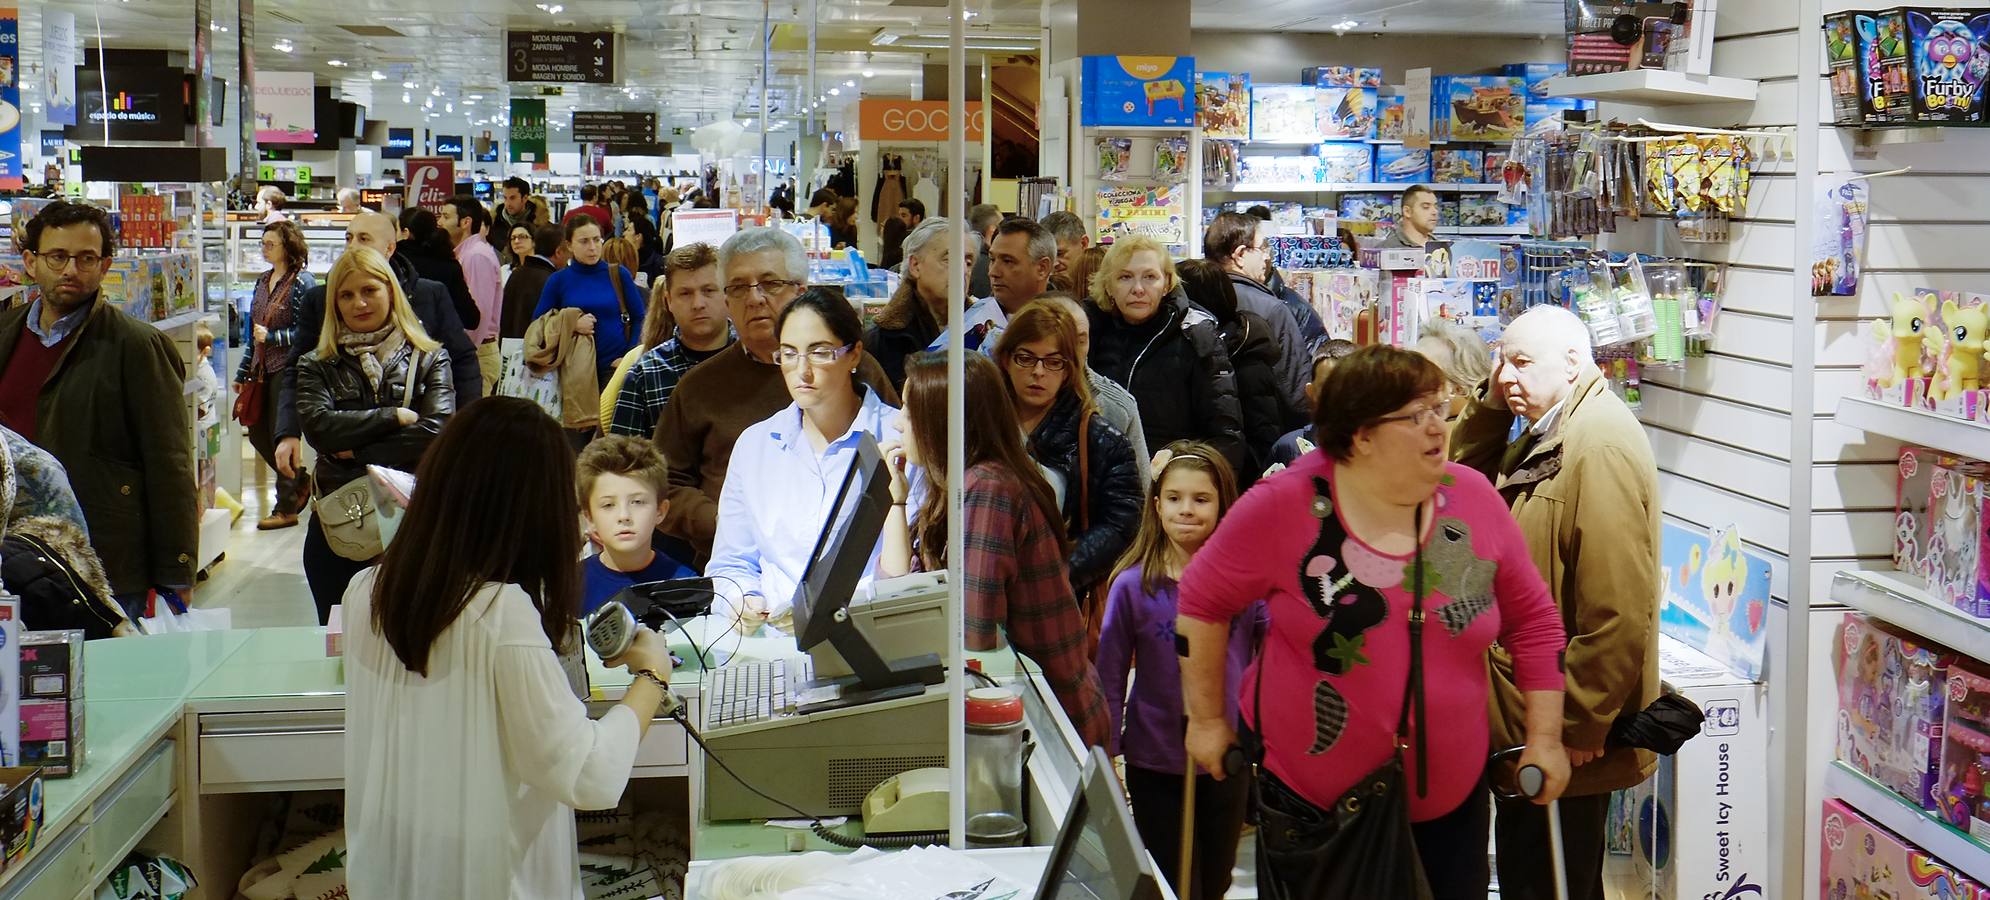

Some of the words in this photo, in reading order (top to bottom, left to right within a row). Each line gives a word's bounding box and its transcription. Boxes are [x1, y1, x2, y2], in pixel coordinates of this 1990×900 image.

[1578, 16, 1601, 29] TABLET
[532, 34, 550, 42] MODA
[551, 35, 577, 44] INFANTIL
[514, 49, 528, 73] 3
[532, 64, 551, 72] MODA
[552, 64, 578, 72] HOMBRE
[532, 73, 556, 81] IMAGEN
[556, 73, 561, 81] Y
[562, 73, 586, 81] SONIDO
[1926, 80, 1974, 98] Furby
[89, 112, 117, 121] espacio
[117, 112, 128, 120] de
[129, 111, 156, 120] música
[511, 131, 545, 140] REGALAR
[438, 144, 462, 153] Clarks
[263, 171, 270, 180] 1
[299, 171, 307, 180] 2
[1716, 743, 1729, 796] House
[1716, 802, 1732, 825] Icy
[1716, 830, 1729, 882] Sweet
